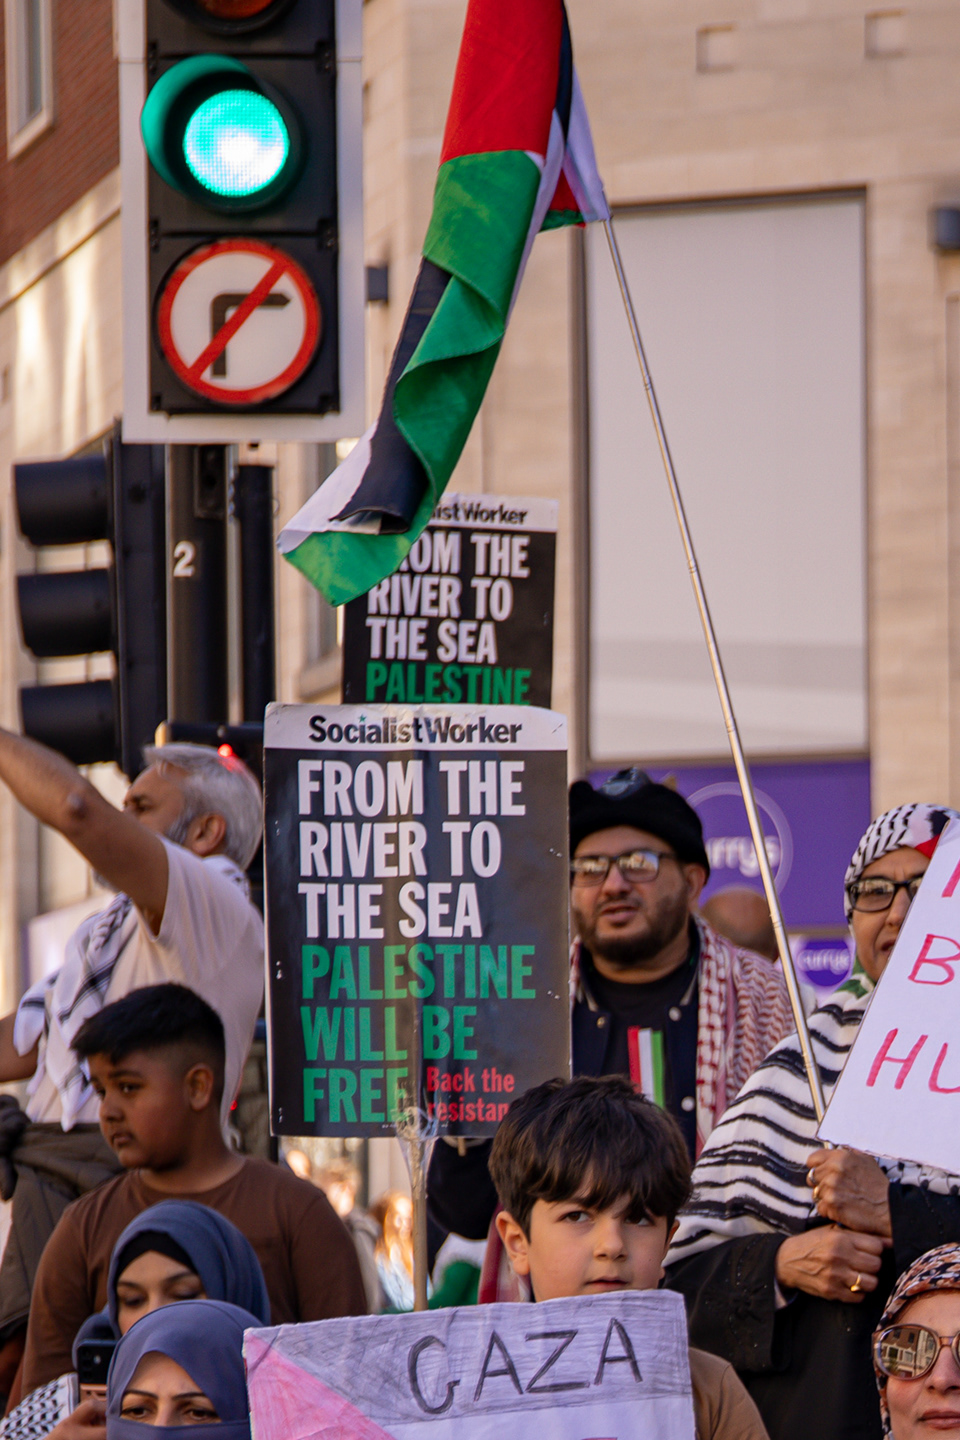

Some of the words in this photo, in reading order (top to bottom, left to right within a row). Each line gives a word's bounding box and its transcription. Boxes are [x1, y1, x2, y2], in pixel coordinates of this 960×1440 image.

[461, 503, 528, 525] Worker
[173, 540, 196, 578] 2
[397, 531, 461, 575] OM
[470, 532, 530, 578] THE
[367, 572, 462, 618] RIVER
[470, 576, 514, 622] TO
[365, 616, 430, 661] THE
[436, 620, 498, 665] SEA
[365, 661, 532, 705] PALESTINE
[298, 759, 424, 817] FROM
[439, 760, 526, 816] THE
[299, 820, 427, 878] RIVER
[442, 820, 501, 878] TO
[298, 882, 385, 939] THE
[398, 881, 483, 939] SEA
[301, 944, 537, 1000] PALESTINE
[300, 1006, 408, 1061] WILL
[422, 1005, 478, 1061] BE
[302, 1067, 409, 1124] FREE
[426, 1066, 476, 1093] Back
[481, 1067, 515, 1093] the
[427, 1096, 510, 1122] resistan
[407, 1317, 644, 1415] GAZA
